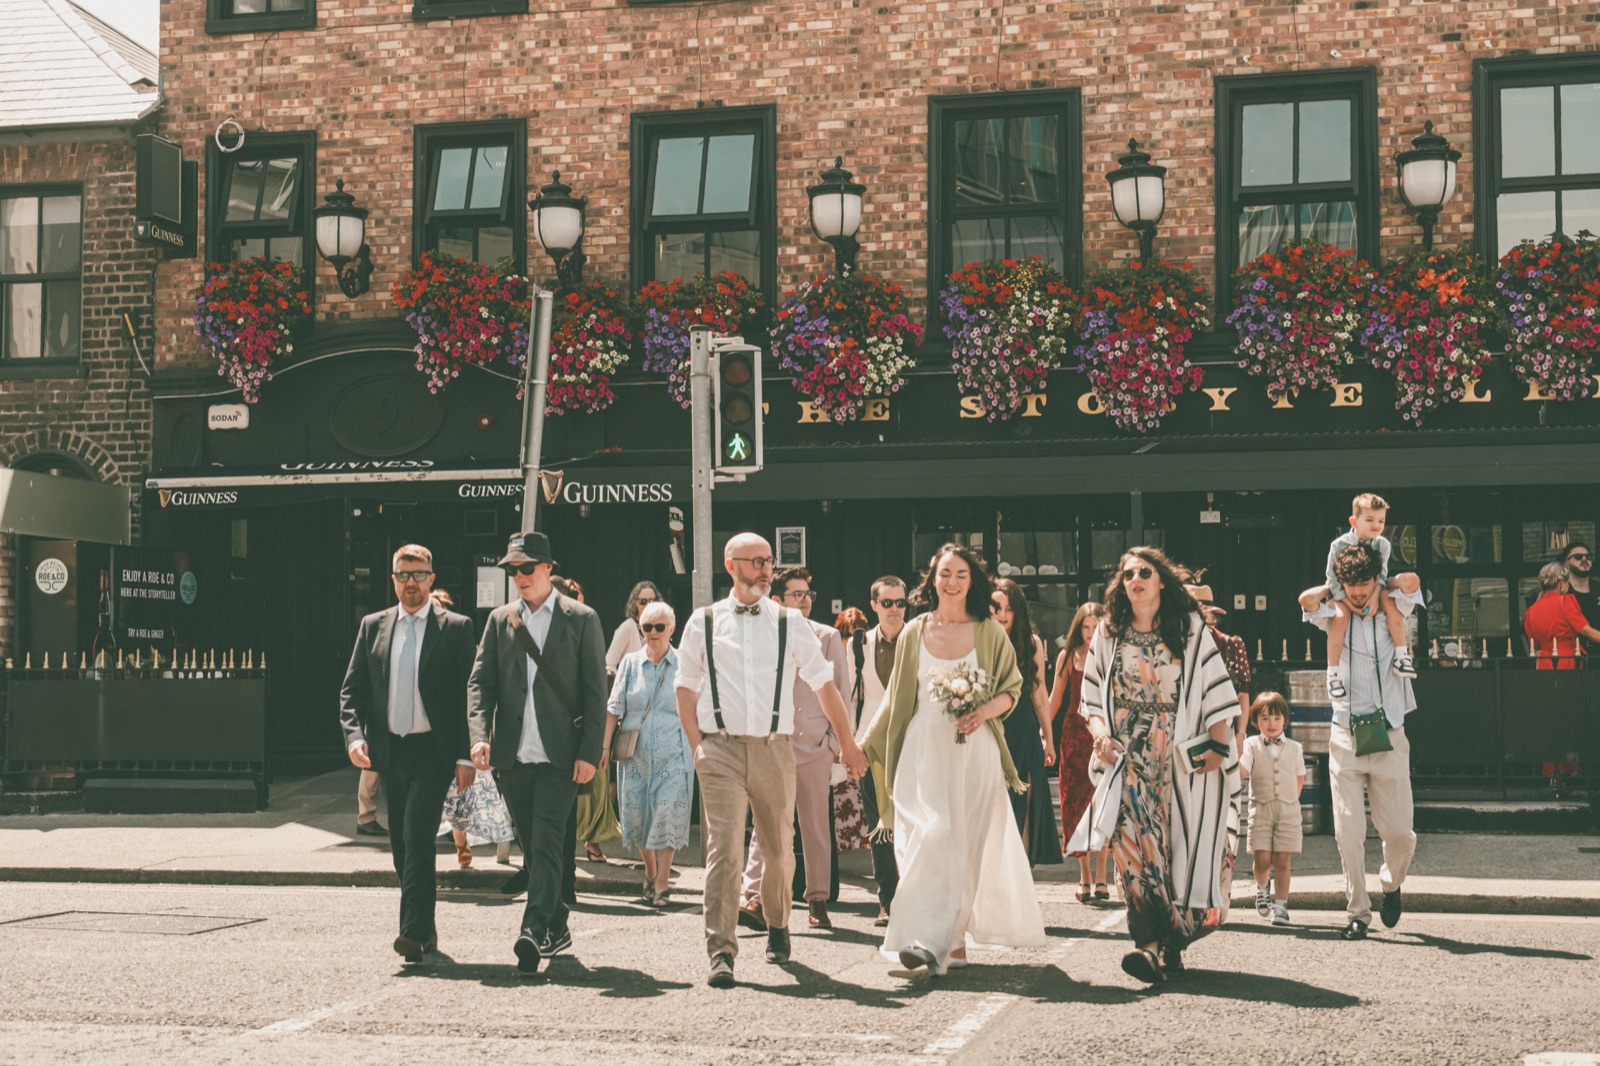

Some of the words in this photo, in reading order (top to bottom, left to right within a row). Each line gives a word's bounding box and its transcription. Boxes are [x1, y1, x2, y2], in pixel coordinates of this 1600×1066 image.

[151, 224, 184, 247] GUINNESS
[210, 414, 238, 422] SODAN
[171, 491, 238, 506] GUINNESS
[563, 481, 673, 503] GUINNESS
[122, 569, 141, 582] ENJOY
[142, 571, 147, 583] A
[148, 571, 159, 584] ROE
[161, 574, 165, 584] &
[166, 573, 175, 585] CO
[120, 587, 132, 598] HERE
[133, 588, 138, 597] AT
[148, 589, 176, 599] STORYTELLER
[128, 628, 136, 638] TRY
